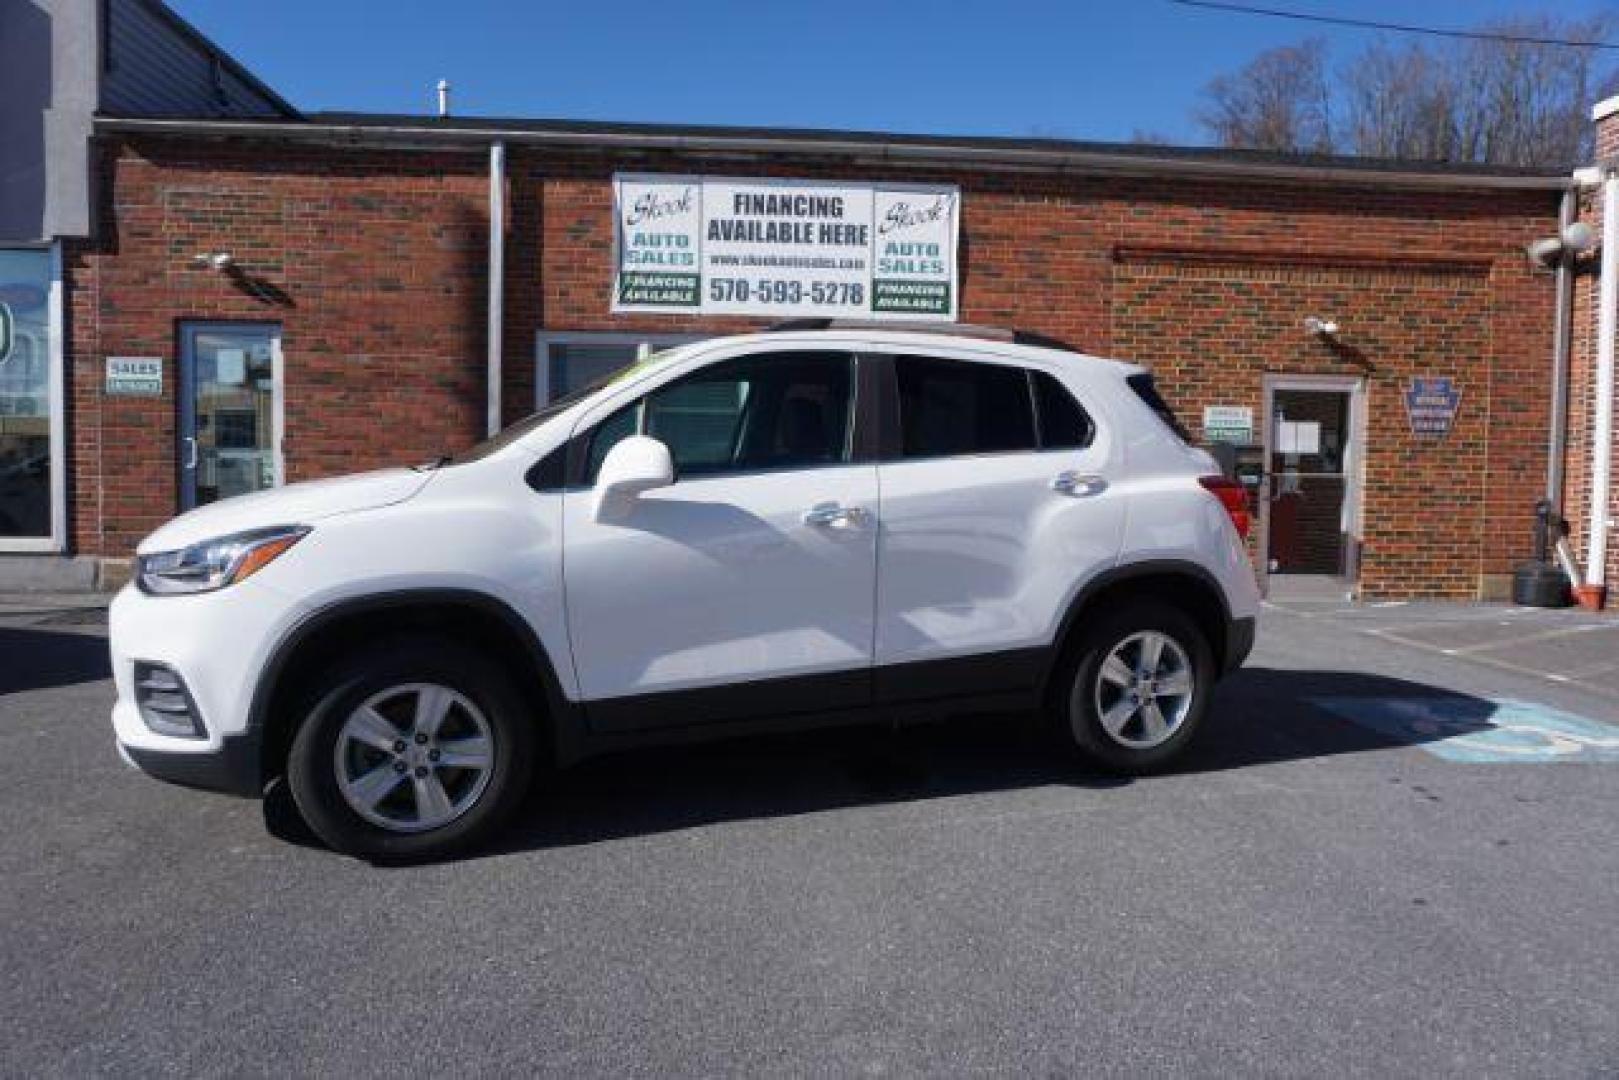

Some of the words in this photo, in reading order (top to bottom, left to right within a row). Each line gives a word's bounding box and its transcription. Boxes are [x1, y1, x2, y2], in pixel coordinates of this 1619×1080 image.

[733, 192, 844, 218] FINANCING
[632, 232, 689, 247] AUTO
[708, 219, 814, 244] AVAILABLE
[819, 223, 869, 246] HERE
[626, 249, 694, 266] SALES
[885, 241, 940, 257] AUTO
[877, 257, 945, 274] SALES
[624, 275, 698, 289] FINANCING
[710, 277, 864, 306] 570-593-5278
